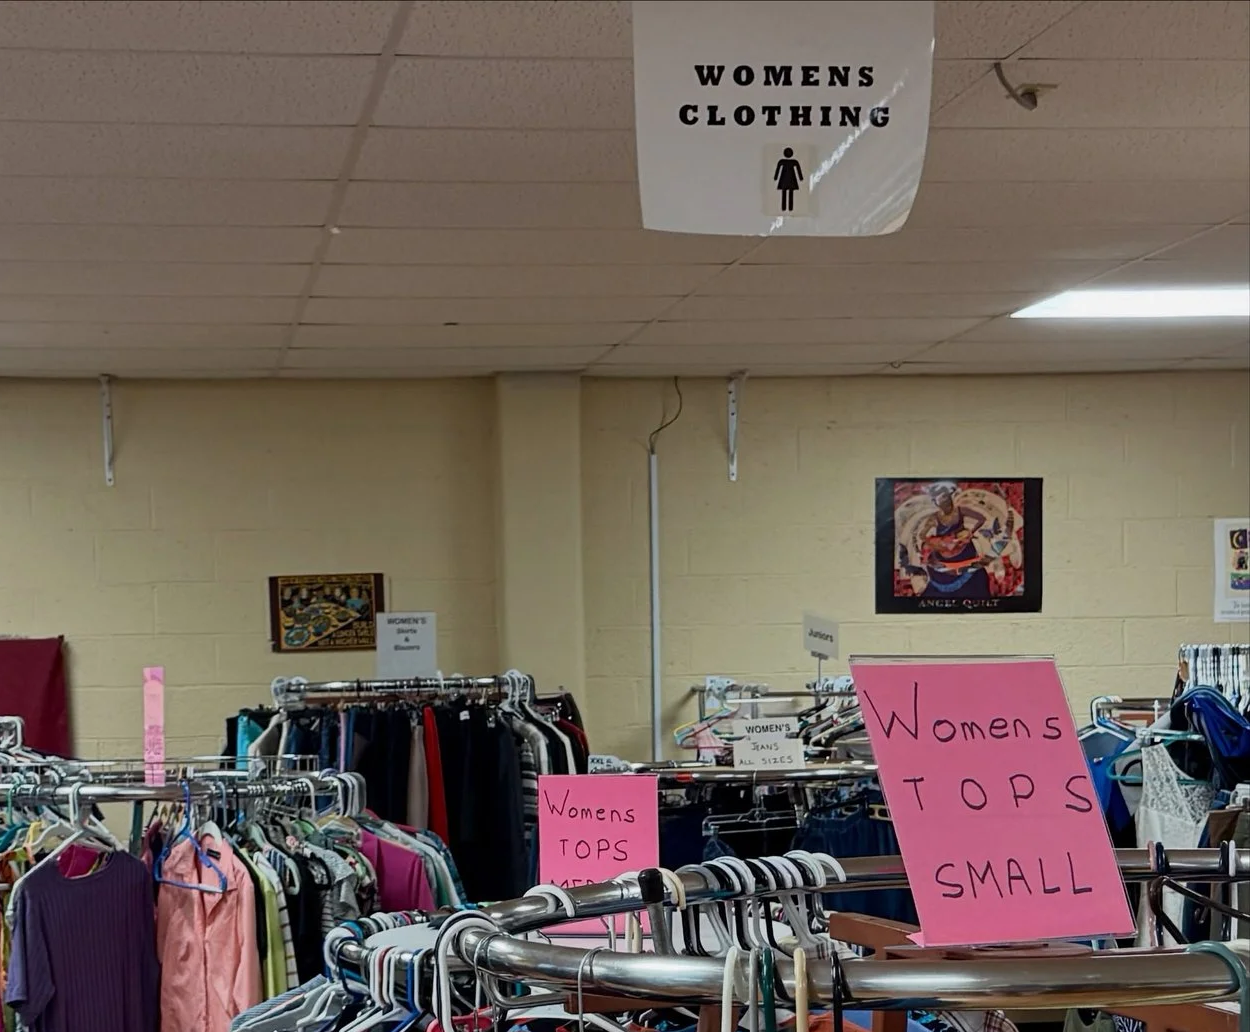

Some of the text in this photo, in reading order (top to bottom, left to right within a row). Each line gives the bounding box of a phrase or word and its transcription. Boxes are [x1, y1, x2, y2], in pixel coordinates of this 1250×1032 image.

[694, 65, 875, 88] WOMENS
[678, 104, 891, 128] CLOTHING
[962, 599, 1000, 609] QUILT
[808, 628, 834, 643] Juniors
[863, 681, 1062, 743] Womens
[745, 723, 791, 734] WOMEN'S
[751, 742, 779, 752] JEANS
[761, 756, 793, 765] SIZES
[902, 774, 1093, 813] TOPS
[543, 788, 636, 824] Womens
[559, 838, 629, 861] TOPS
[935, 851, 1093, 899] SMALL
